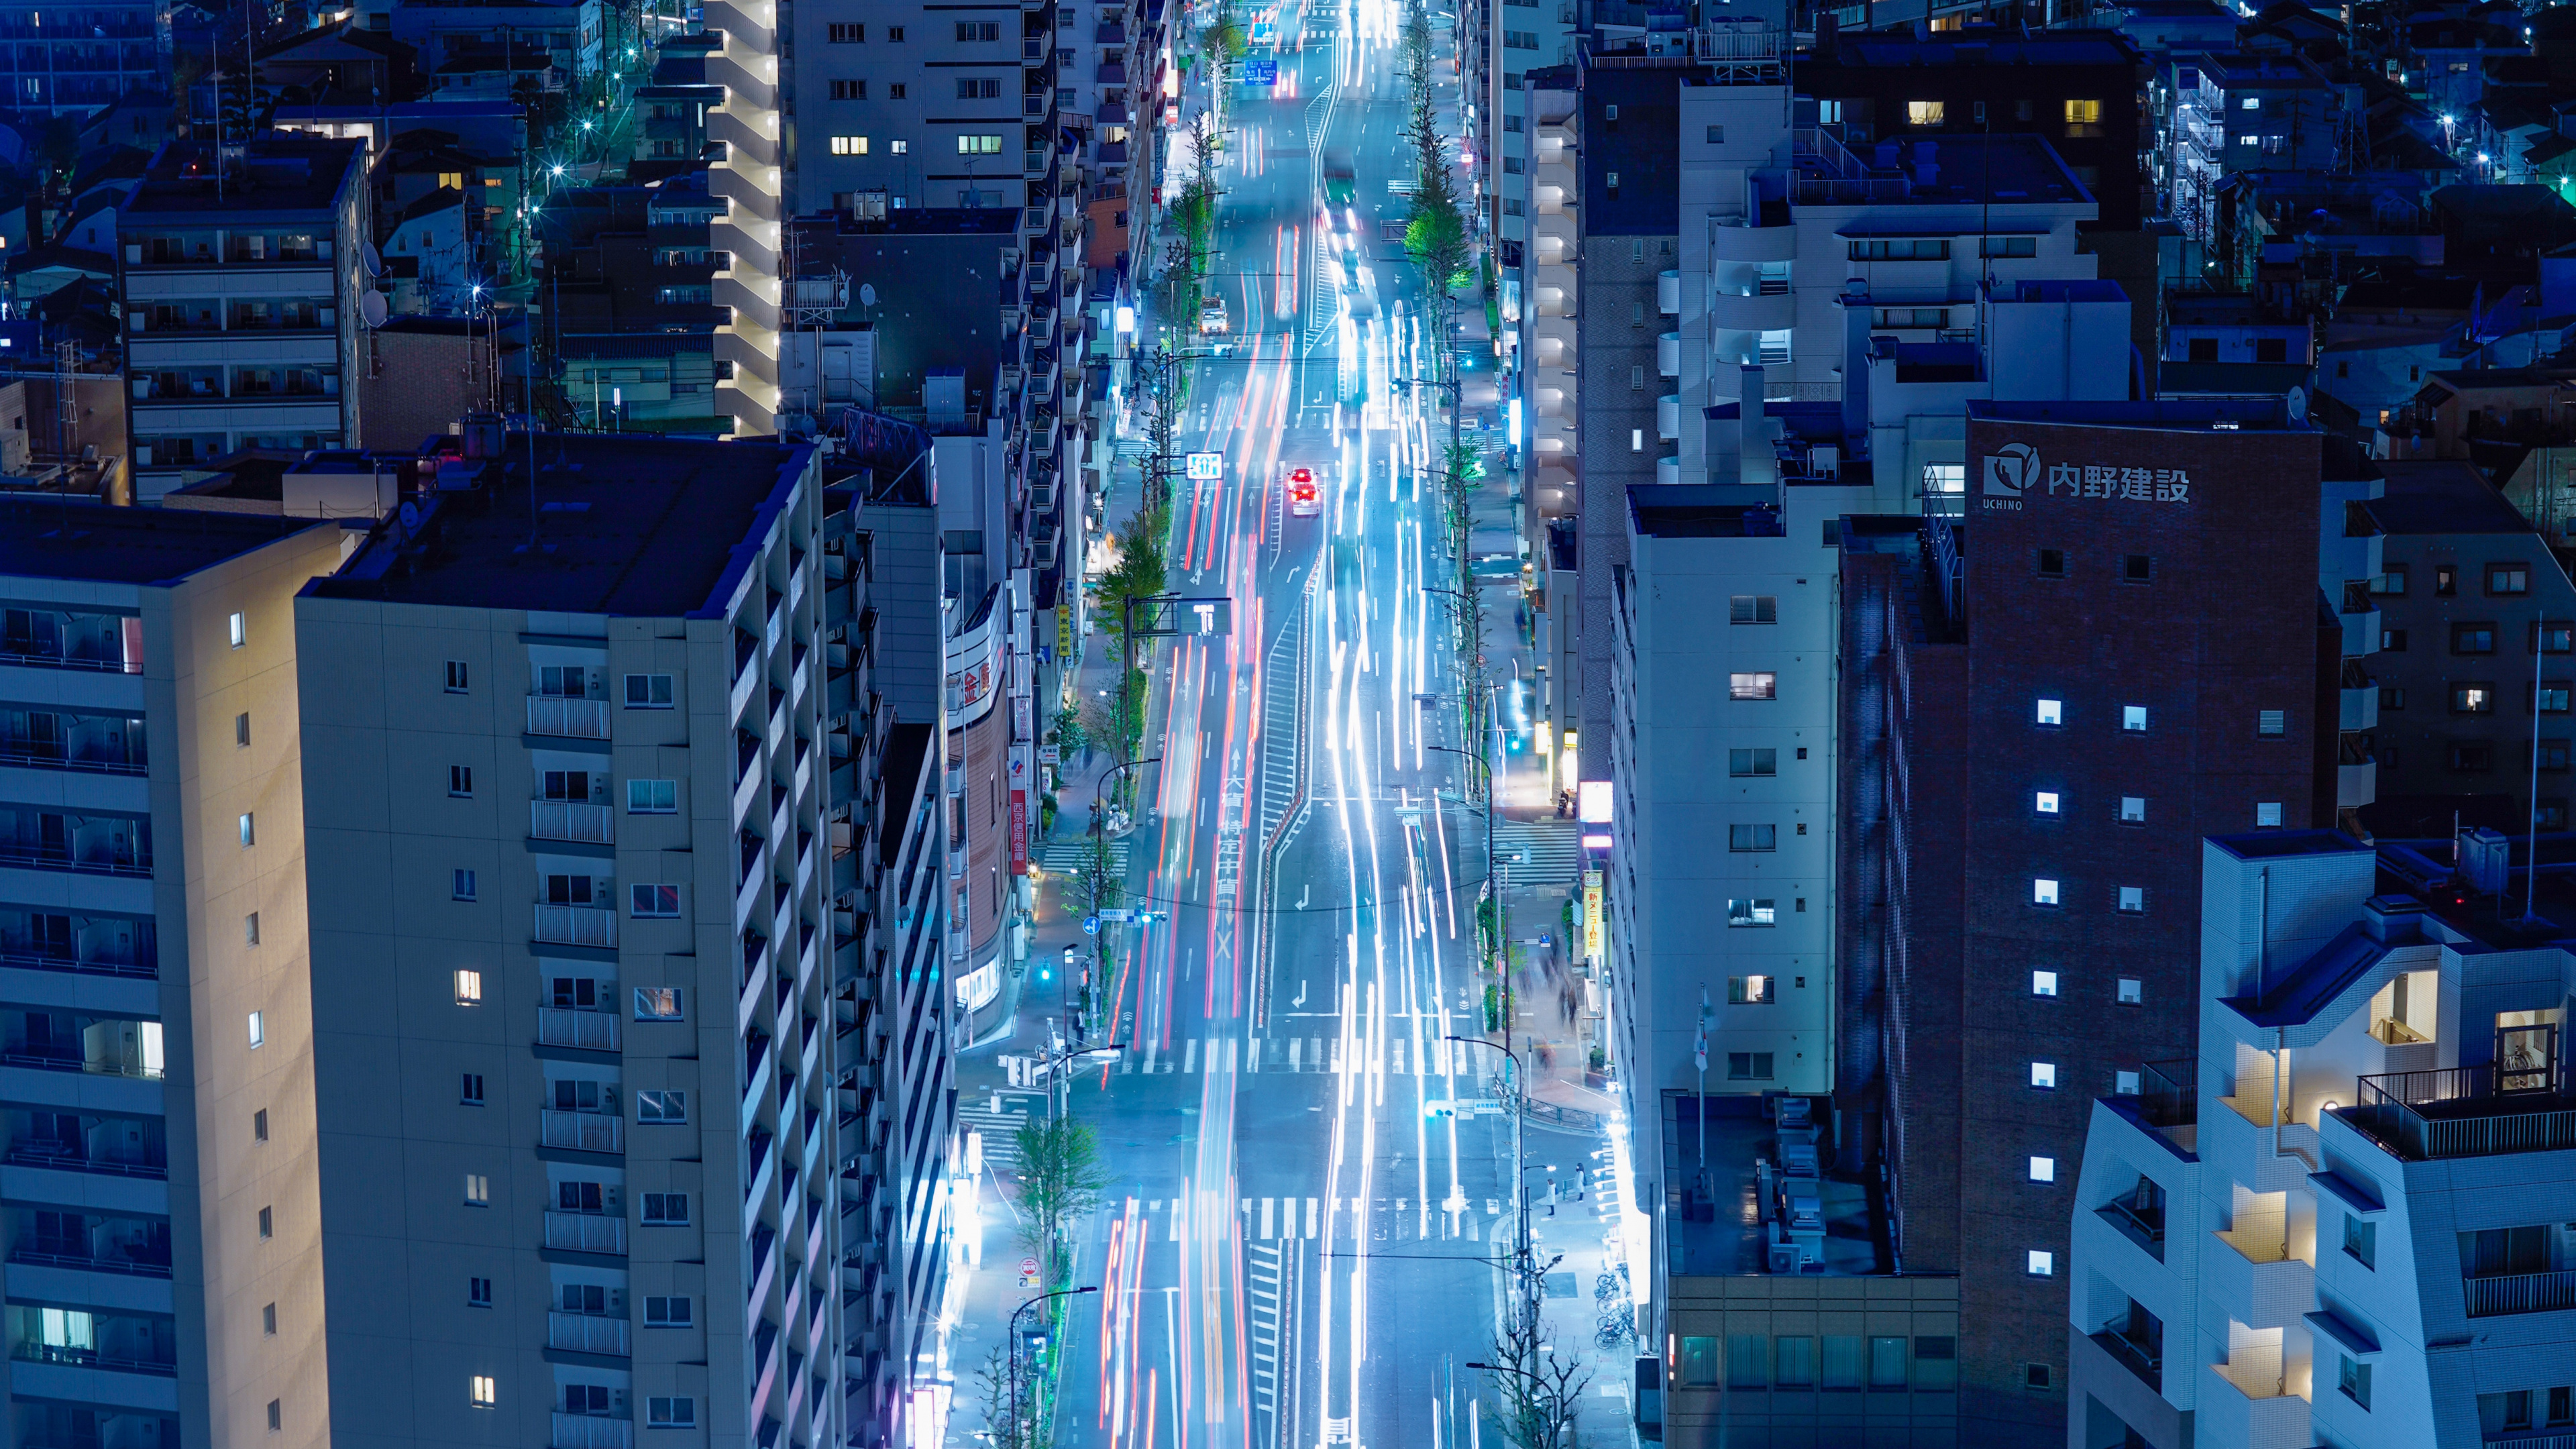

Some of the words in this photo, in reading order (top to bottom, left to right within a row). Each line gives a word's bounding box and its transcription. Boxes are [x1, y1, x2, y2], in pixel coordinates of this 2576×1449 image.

[2048, 462, 2190, 504] 内野建設
[1983, 498, 2023, 511] UCHINO
[1059, 617, 1069, 653] 東京新聞
[1013, 802, 1024, 861] 西京信用金庫
